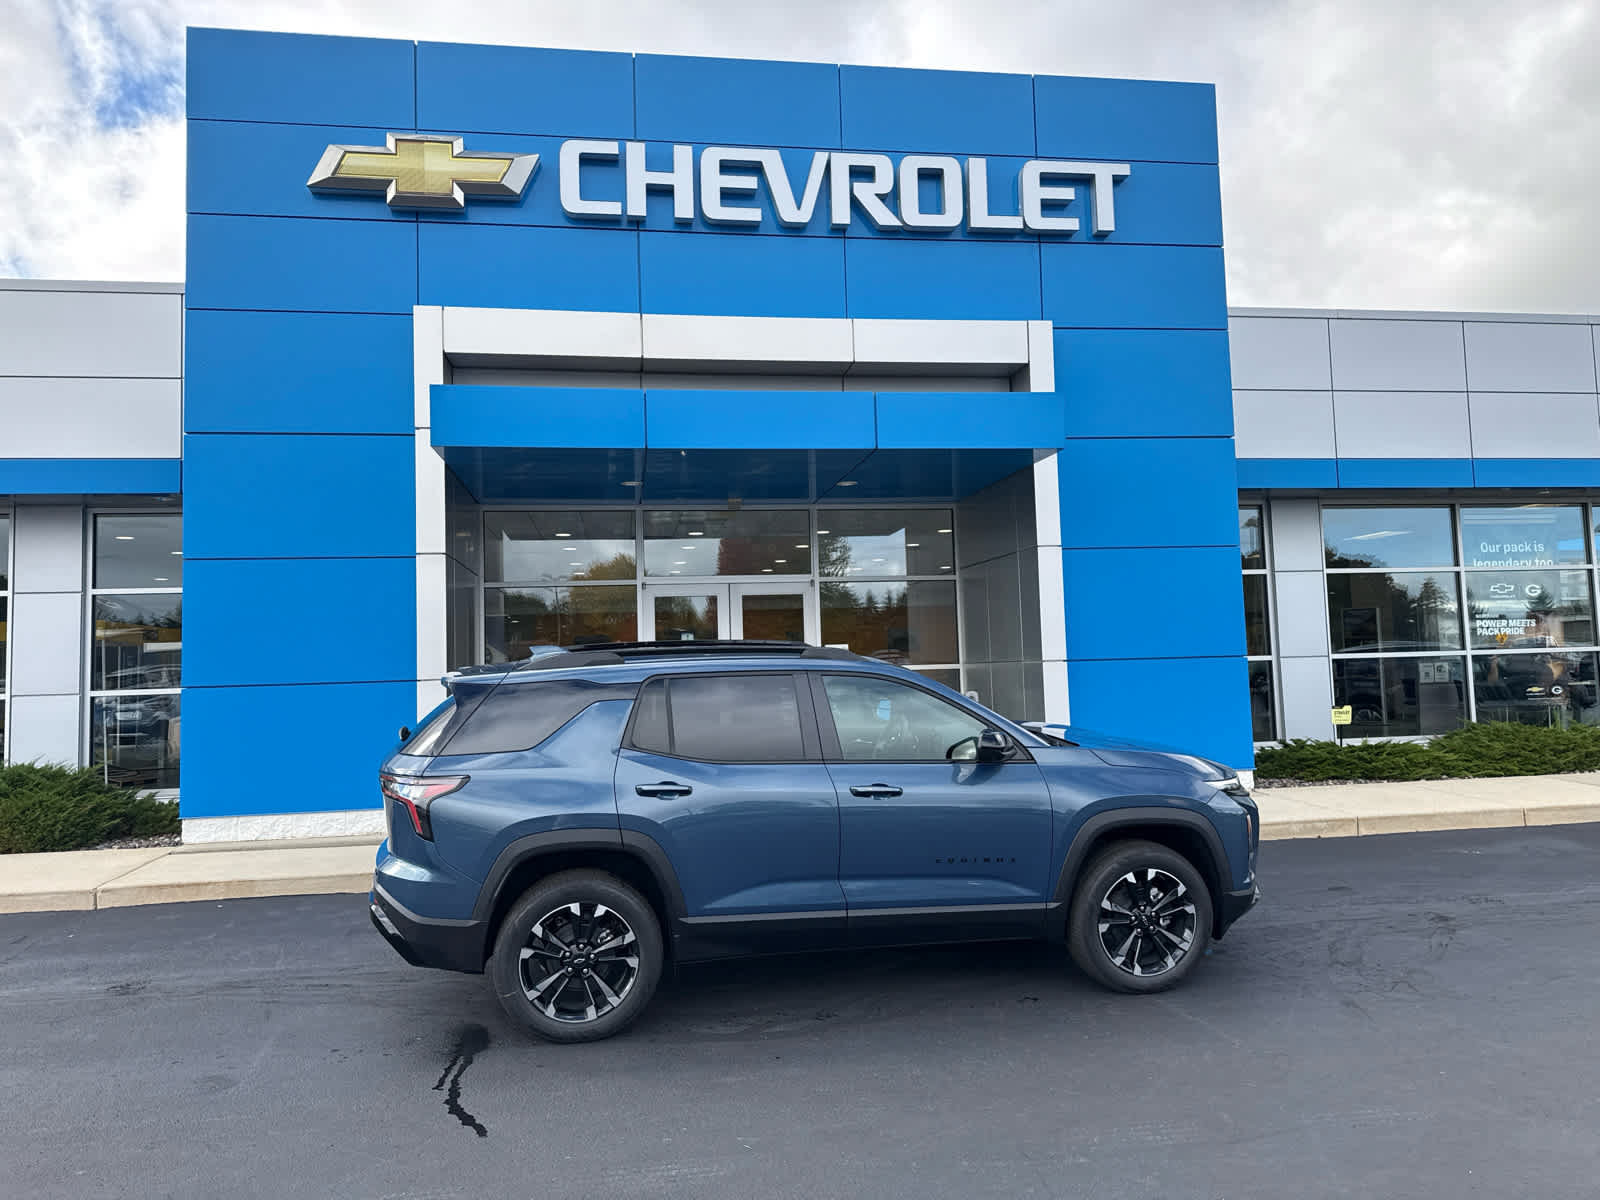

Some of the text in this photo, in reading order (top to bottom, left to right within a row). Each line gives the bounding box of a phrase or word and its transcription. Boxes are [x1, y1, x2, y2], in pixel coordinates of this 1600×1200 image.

[559, 139, 1133, 236] CHEVROLET
[1480, 540, 1545, 555] Our pack is
[1473, 557, 1532, 567] legendary
[1525, 584, 1541, 596] G
[1476, 619, 1537, 628] POWER MEETS
[1476, 627, 1526, 636] PACK PRIDE
[1551, 686, 1563, 695] G
